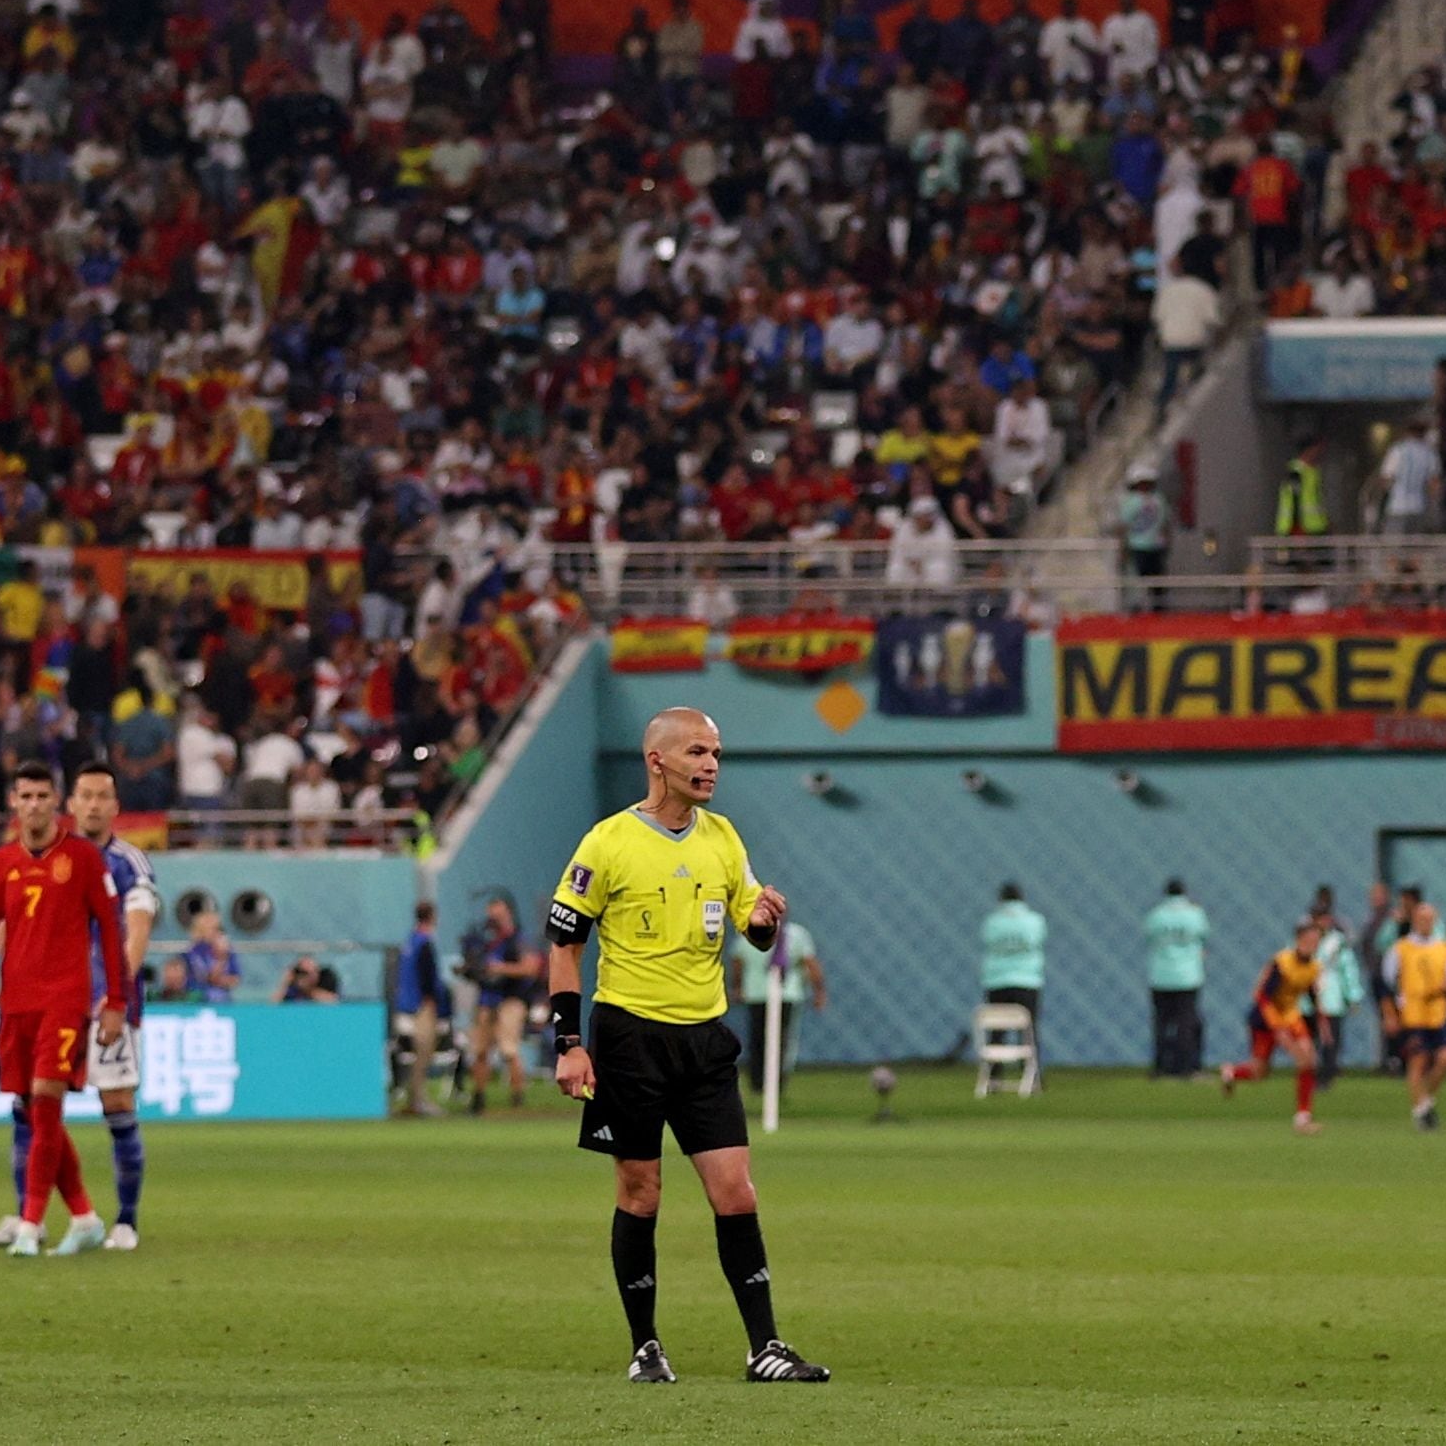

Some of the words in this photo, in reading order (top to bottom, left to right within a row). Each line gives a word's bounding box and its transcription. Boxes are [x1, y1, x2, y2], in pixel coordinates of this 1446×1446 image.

[23, 885, 42, 918] 7
[550, 902, 577, 925] FIFA
[58, 1028, 78, 1059] 7
